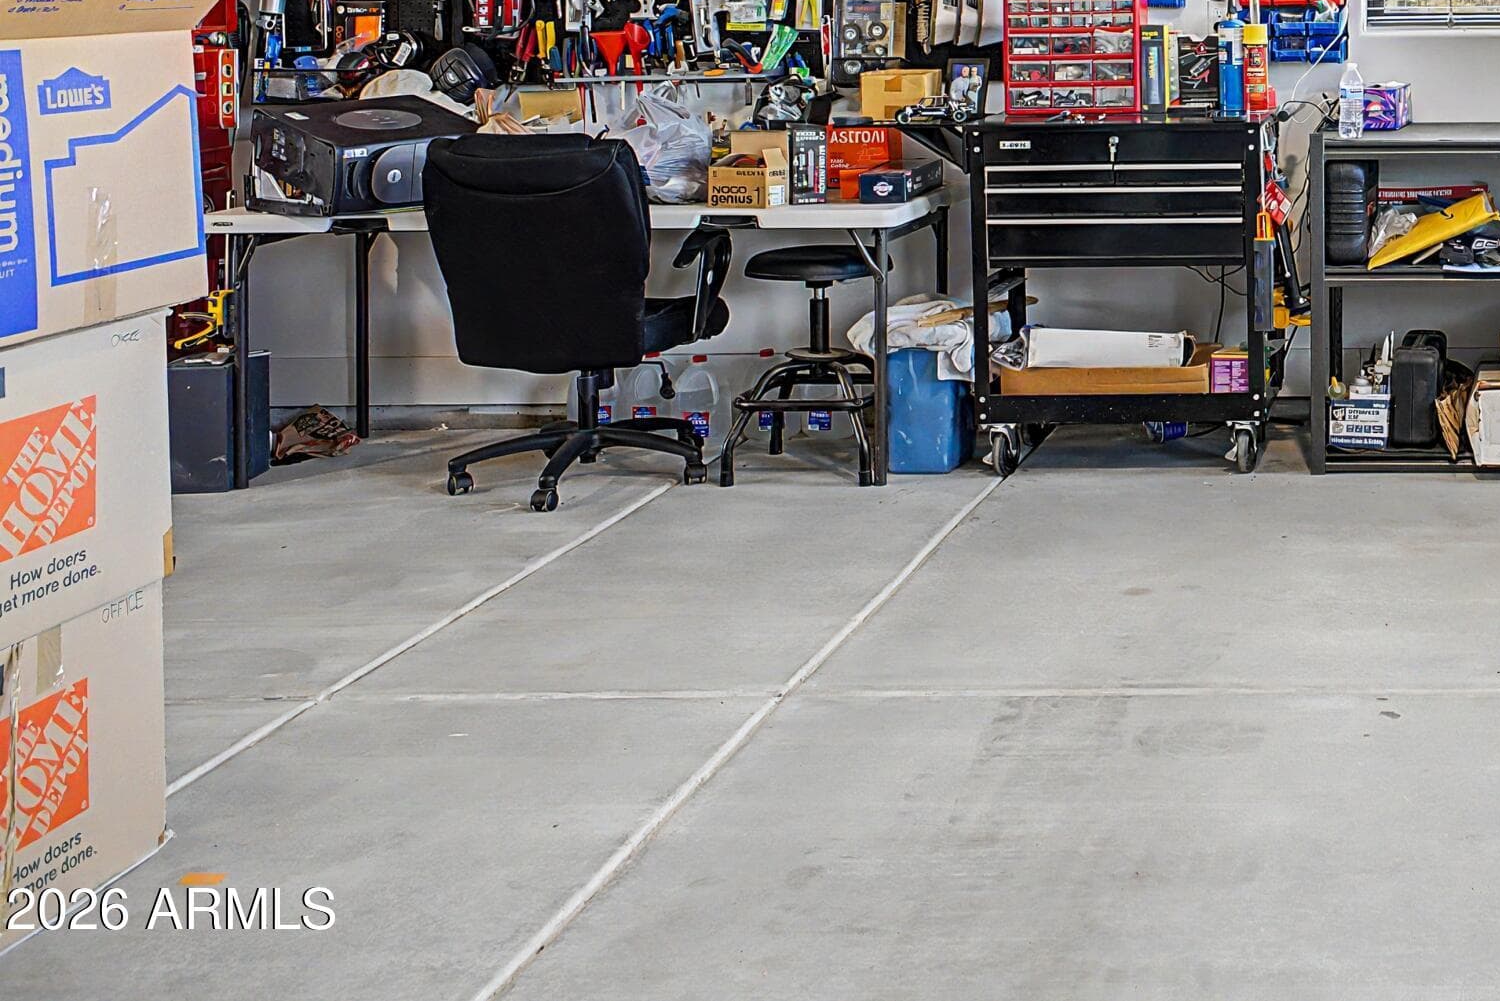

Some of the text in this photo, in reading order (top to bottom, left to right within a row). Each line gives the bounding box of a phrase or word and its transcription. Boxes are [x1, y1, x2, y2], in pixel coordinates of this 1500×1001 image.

[45, 83, 104, 109] LOWE'S
[711, 187, 761, 206] genius 1
[712, 185, 748, 194] NOCO
[2, 426, 49, 488] THE
[0, 399, 96, 559] HOME
[35, 446, 96, 545] DEPOT
[10, 550, 87, 590] How doers
[21, 579, 60, 606] more
[102, 590, 144, 623] OFFICE
[32, 729, 89, 836] DEPOT
[44, 831, 82, 865] doers
[23, 844, 97, 899] more done.
